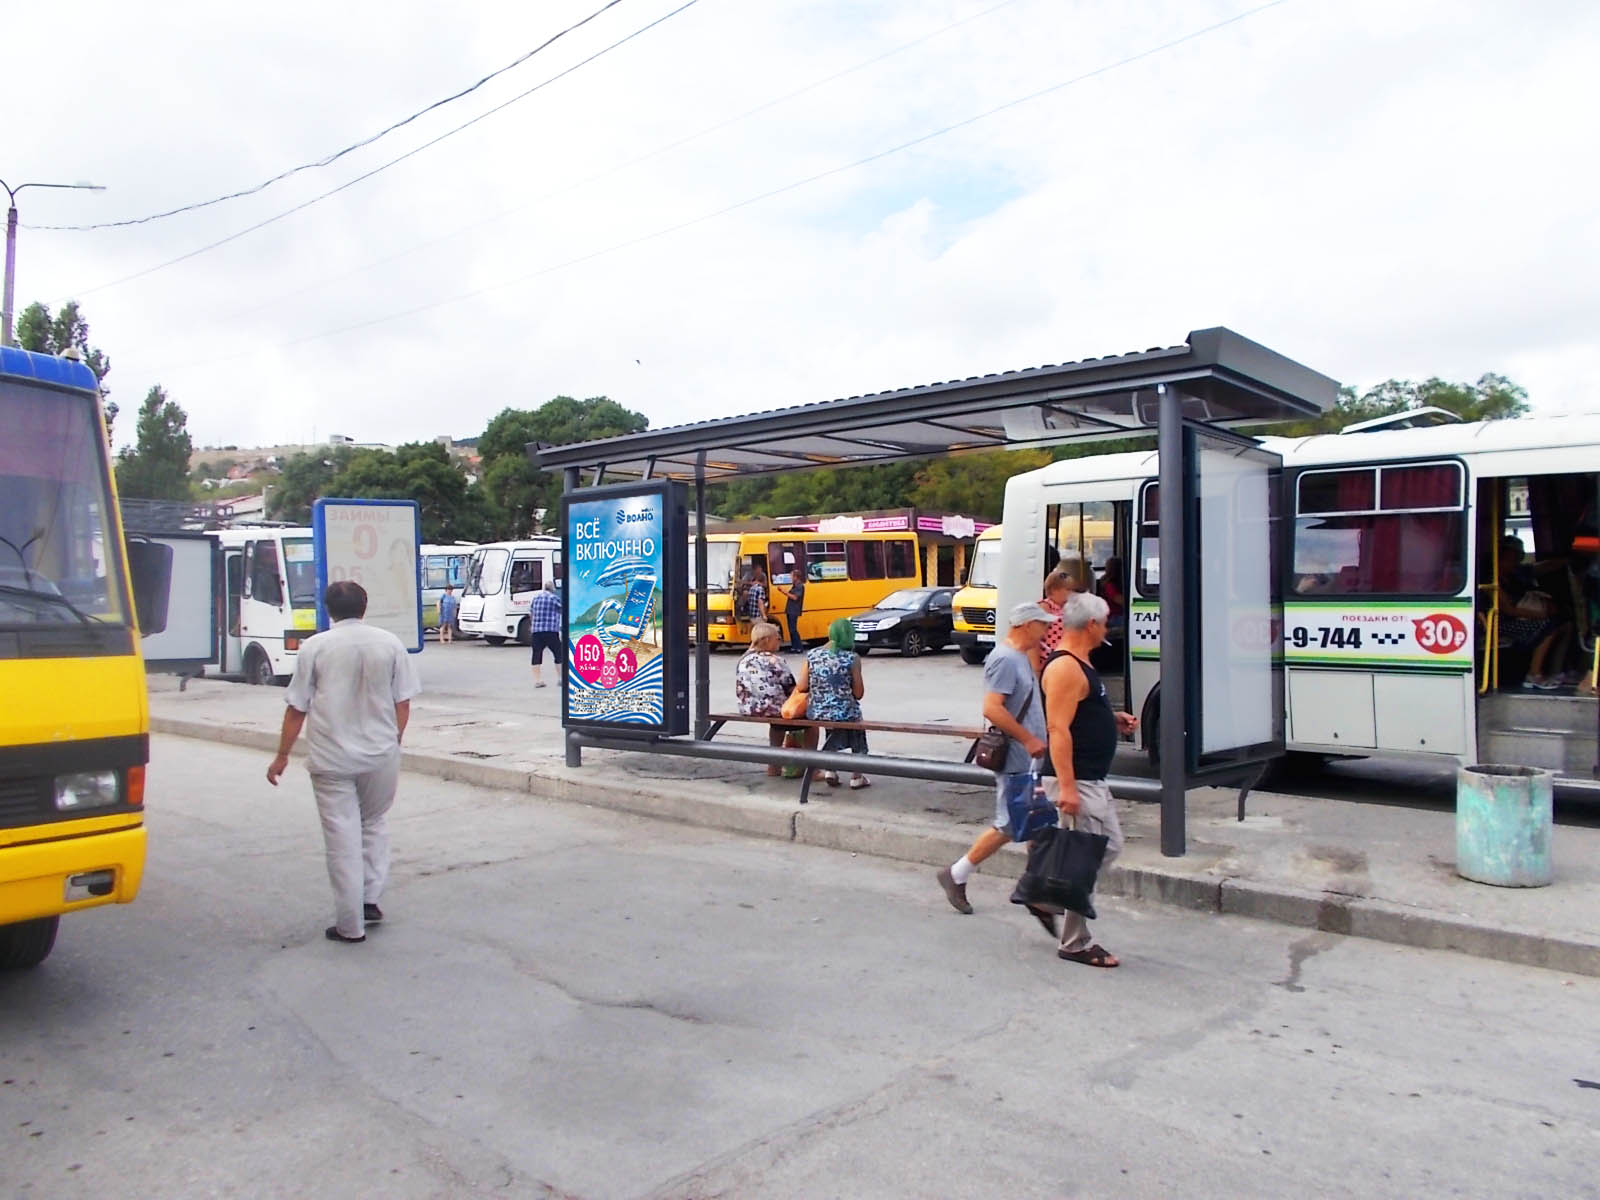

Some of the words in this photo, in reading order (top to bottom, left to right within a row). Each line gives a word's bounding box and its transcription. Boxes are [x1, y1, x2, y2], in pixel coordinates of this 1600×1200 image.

[576, 517, 600, 540] ВСЁ
[576, 538, 655, 560] ВКЛЮЧЕНО
[579, 644, 600, 662] 150
